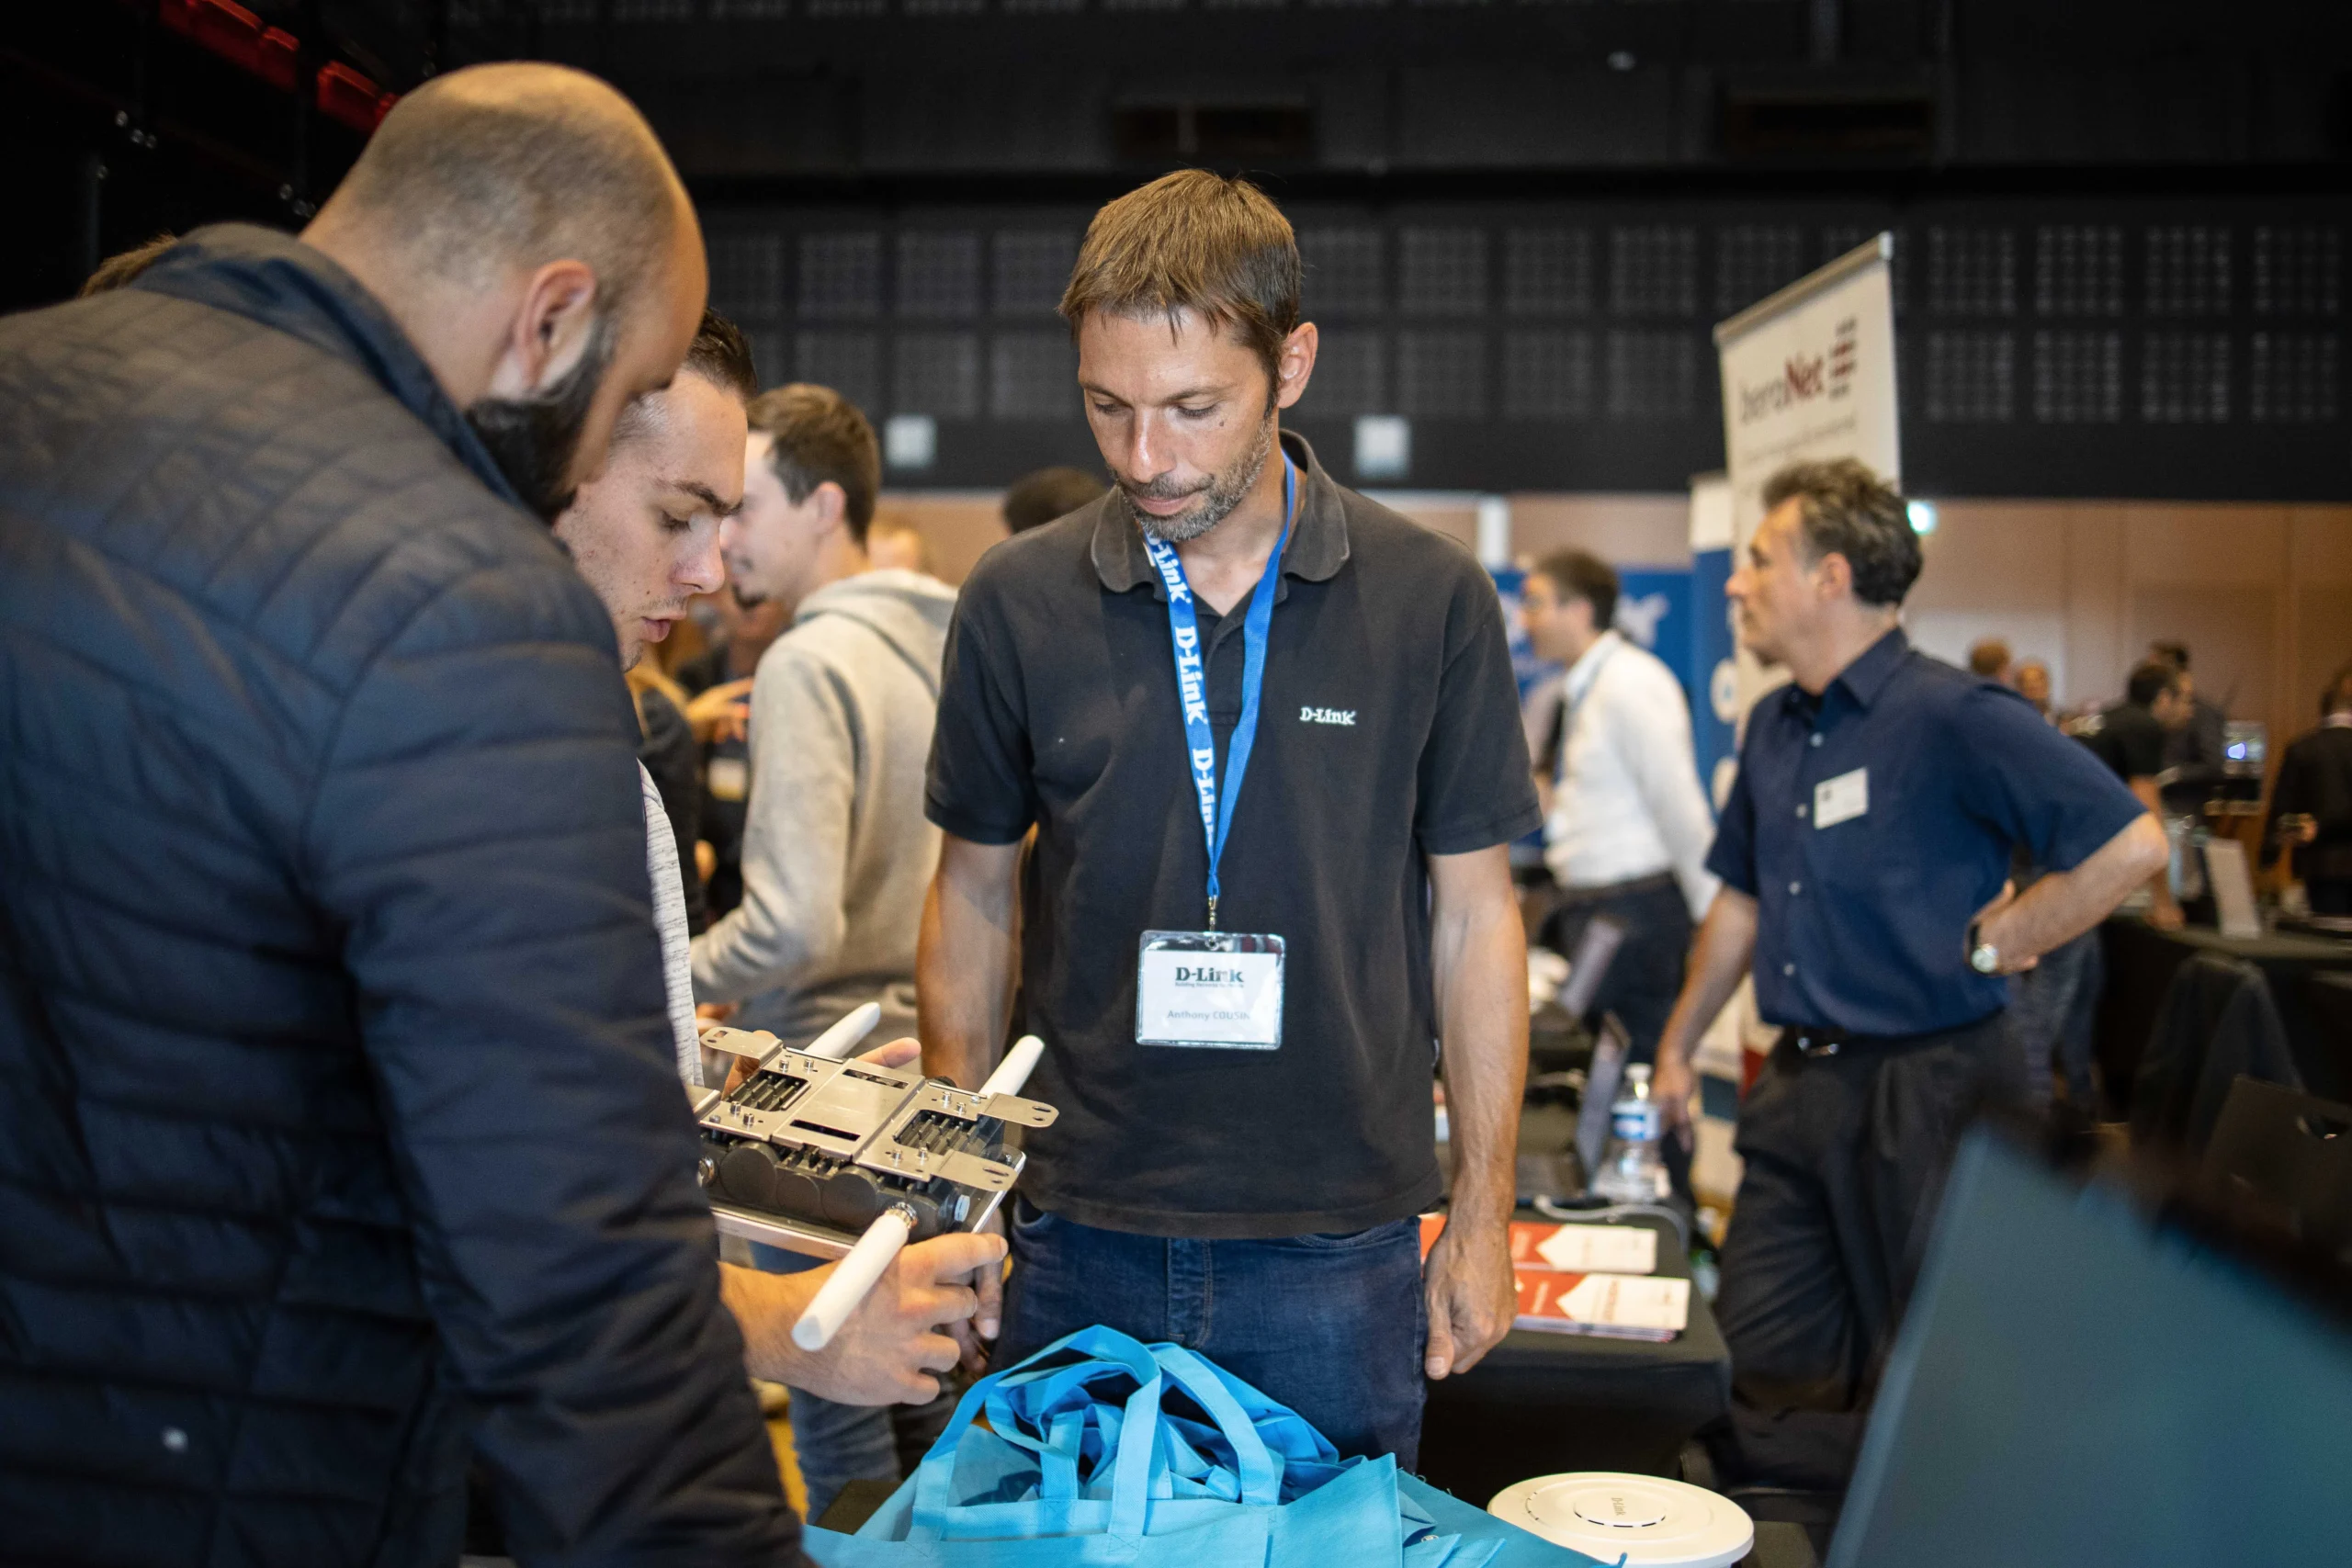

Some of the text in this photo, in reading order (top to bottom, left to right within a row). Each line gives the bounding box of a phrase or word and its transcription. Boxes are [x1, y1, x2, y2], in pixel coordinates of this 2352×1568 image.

[1175, 626, 1209, 726] D-Link
[1299, 705, 1357, 726] D-Link
[1167, 1010, 1210, 1022] Anthony
